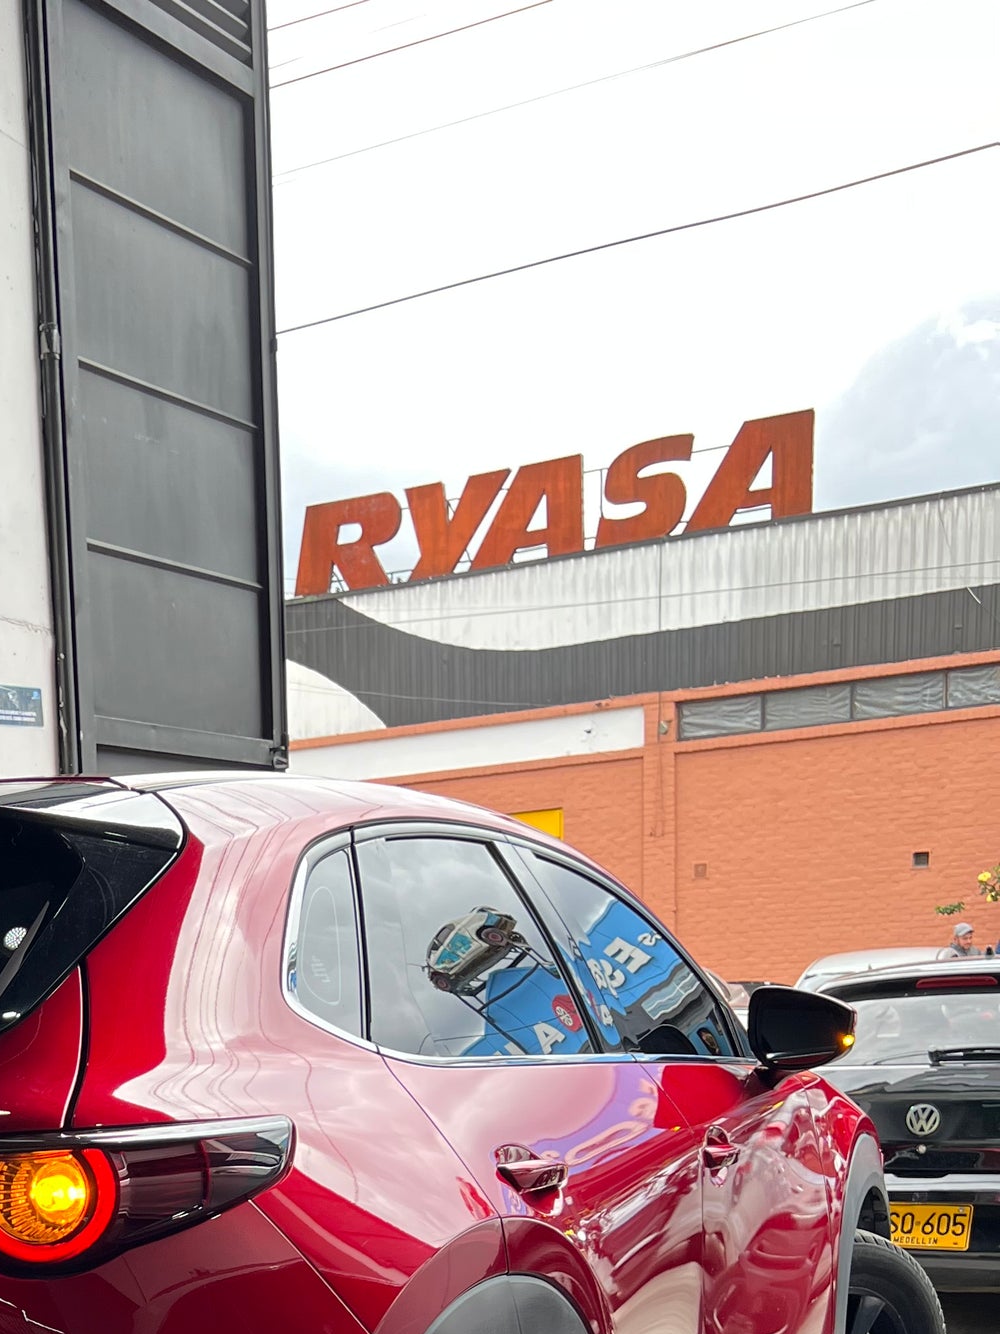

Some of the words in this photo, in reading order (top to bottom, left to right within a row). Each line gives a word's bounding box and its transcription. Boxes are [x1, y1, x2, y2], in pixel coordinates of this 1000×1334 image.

[294, 408, 815, 598] RYASA
[921, 1212, 967, 1237] 605
[893, 1235, 939, 1245] MEDELLIN
